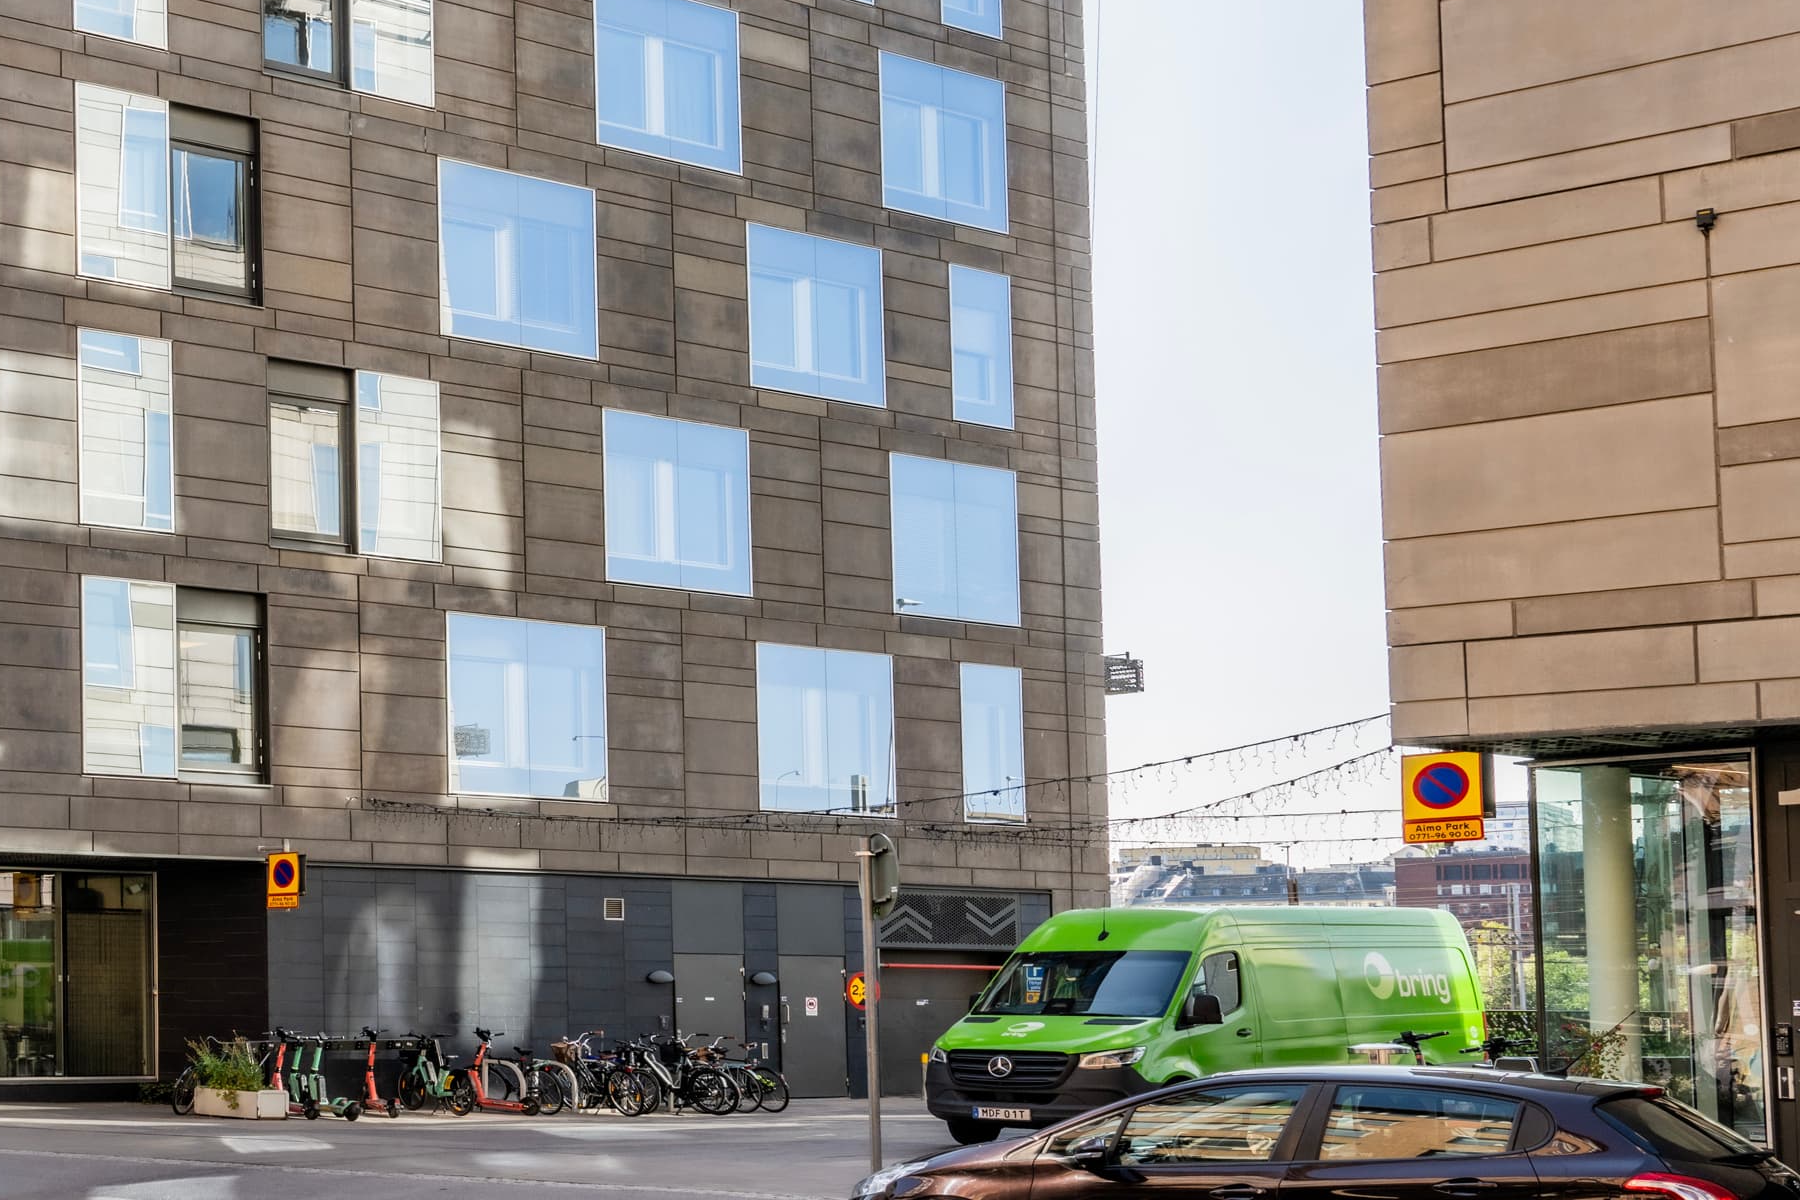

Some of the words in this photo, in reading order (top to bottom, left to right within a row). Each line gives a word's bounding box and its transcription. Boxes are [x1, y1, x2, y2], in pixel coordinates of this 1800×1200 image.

[1445, 822, 1470, 830] Park
[1409, 832, 1446, 840] 0771-96
[1395, 968, 1451, 1004] bring
[981, 1109, 1000, 1117] MDF
